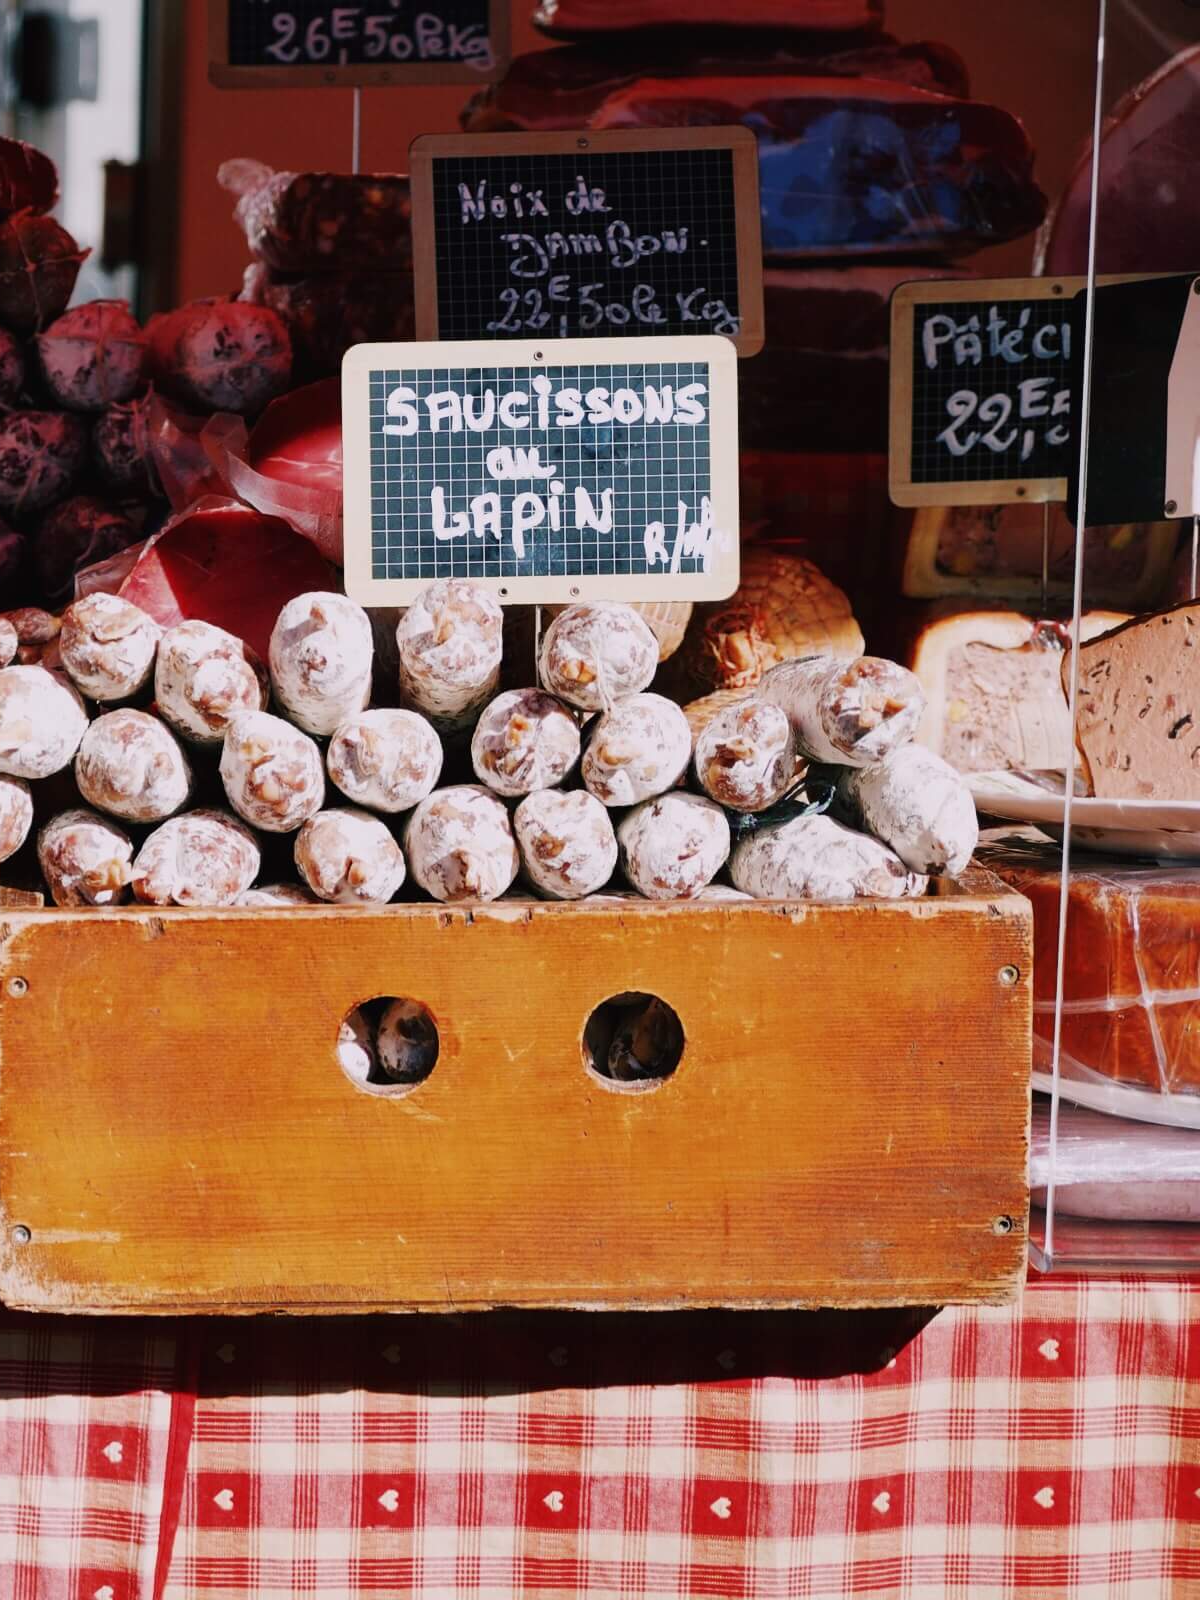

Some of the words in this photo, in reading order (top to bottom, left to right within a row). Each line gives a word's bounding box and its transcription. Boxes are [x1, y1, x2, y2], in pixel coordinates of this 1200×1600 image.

[458, 179, 549, 224] Noix
[565, 175, 613, 216] de
[485, 445, 558, 480] au
